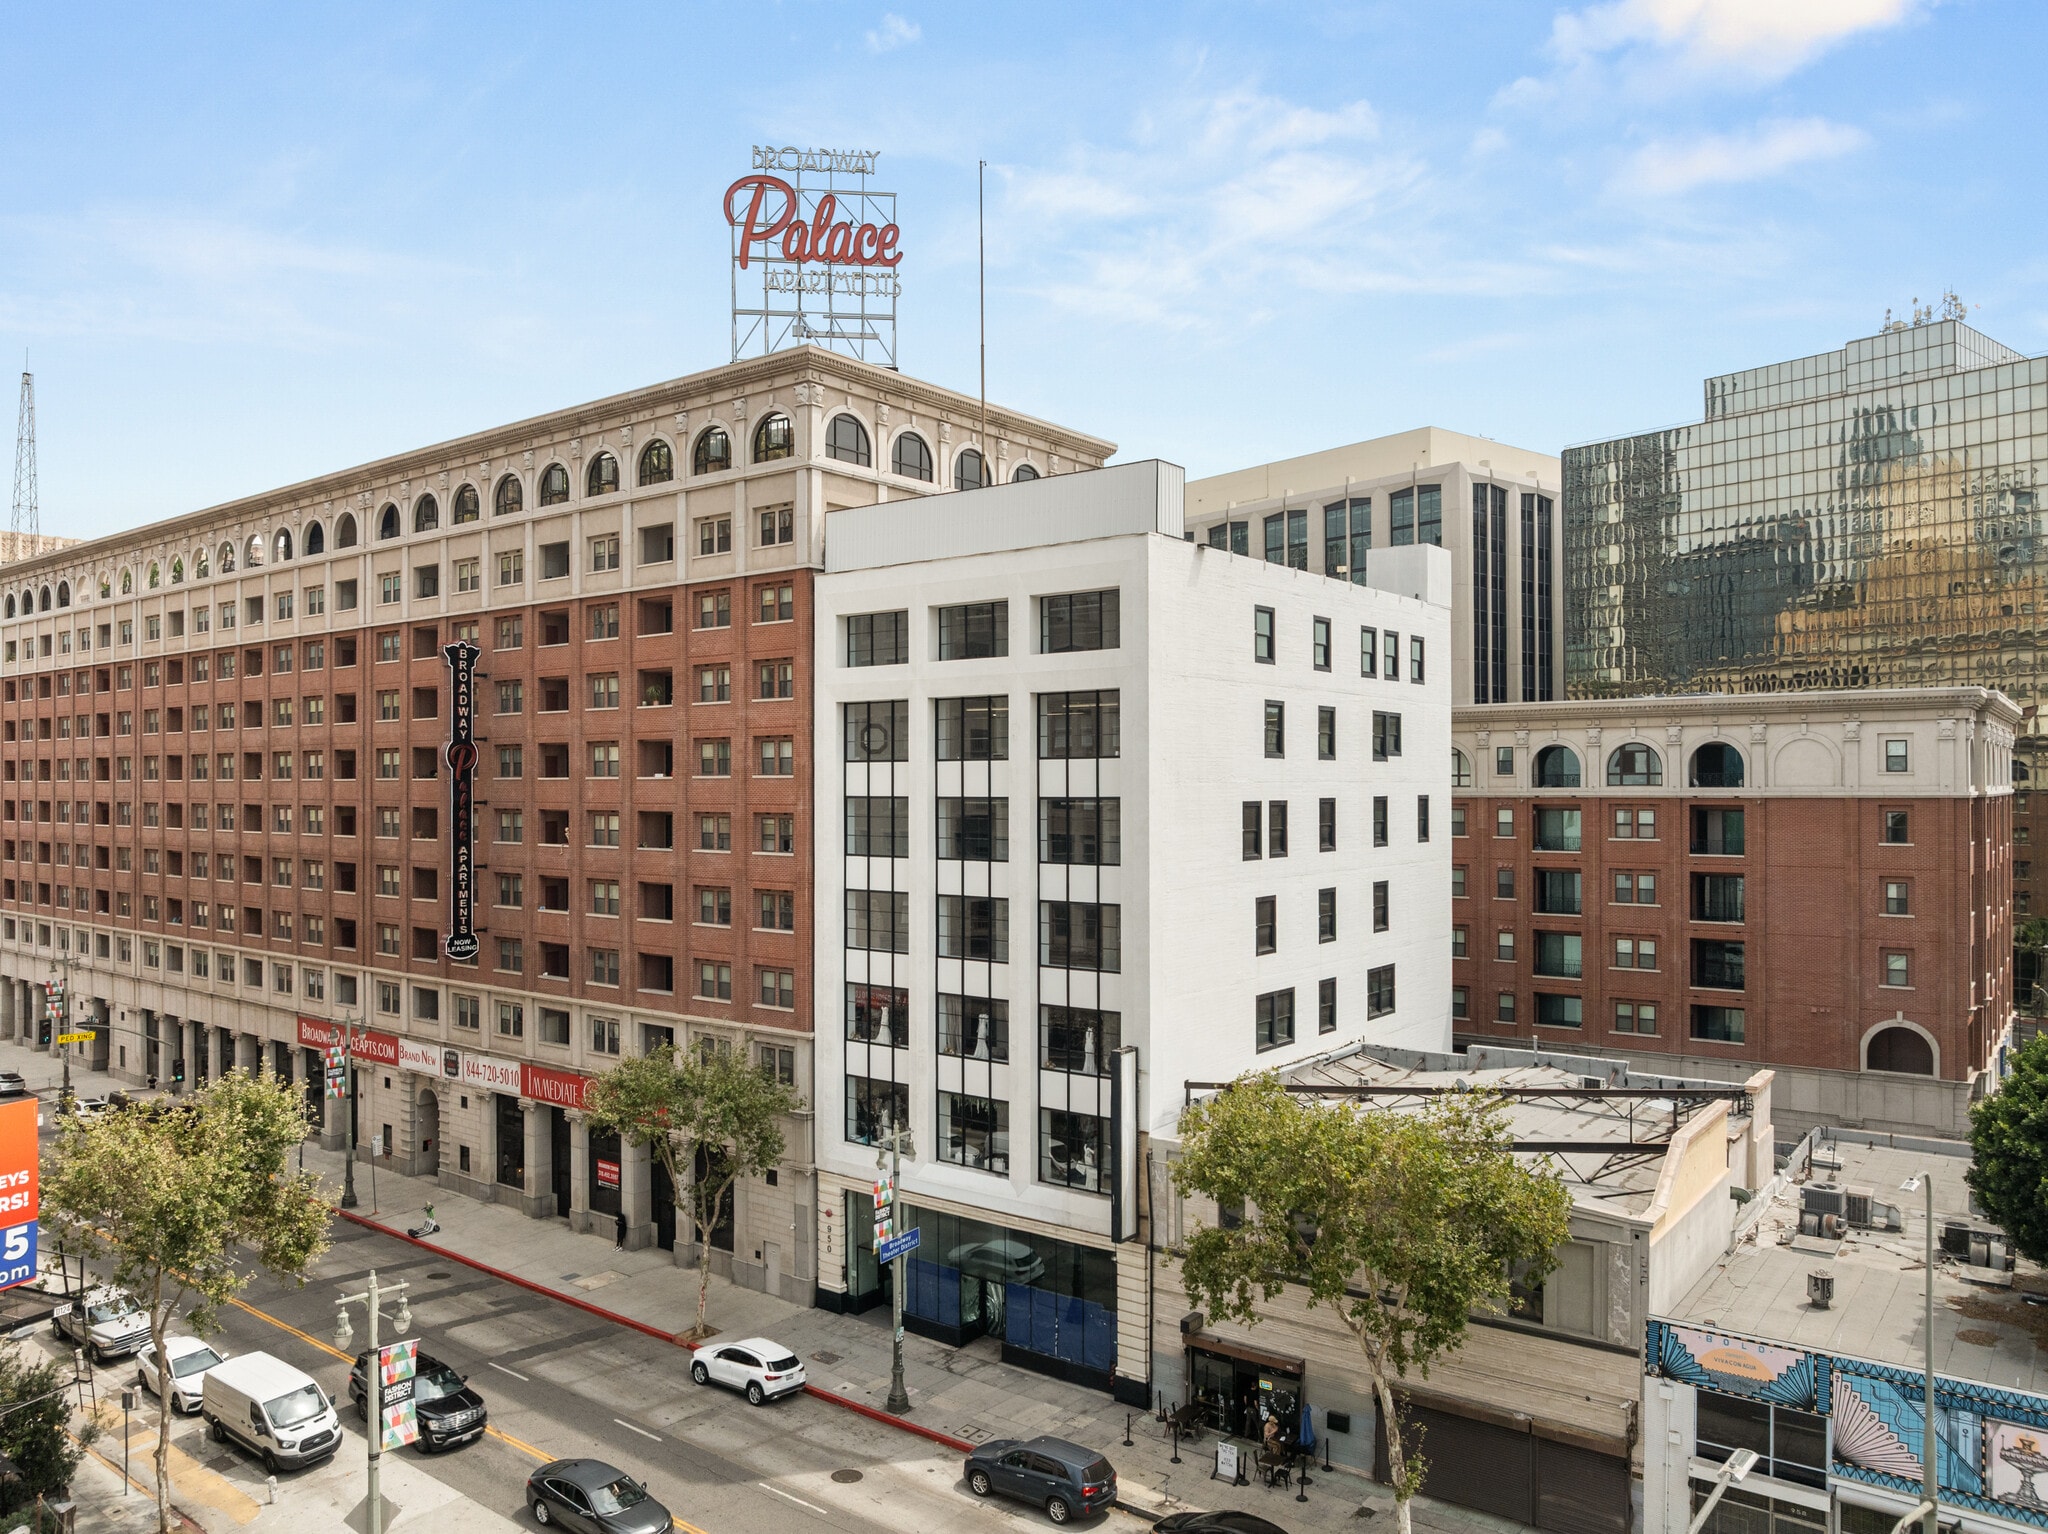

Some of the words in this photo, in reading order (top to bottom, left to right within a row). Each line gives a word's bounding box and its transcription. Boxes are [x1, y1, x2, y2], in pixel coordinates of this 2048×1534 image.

[752, 145, 881, 175] BROADWAY
[723, 174, 903, 270] Palace
[766, 268, 902, 297] APARTMENTS
[457, 649, 469, 739] BROADWAY
[458, 846, 468, 934] APARTMENTS
[77, 1033, 93, 1041] XING
[466, 1060, 519, 1087] 844-720-5010
[528, 1067, 578, 1106] IMMEDIATE
[3, 1225, 29, 1261] 5
[889, 1235, 911, 1249] Broadway
[900, 1238, 918, 1251] District
[1706, 1335, 1765, 1354] BOLD
[385, 1380, 412, 1396] FASHION
[385, 1388, 411, 1404] DISTRICT
